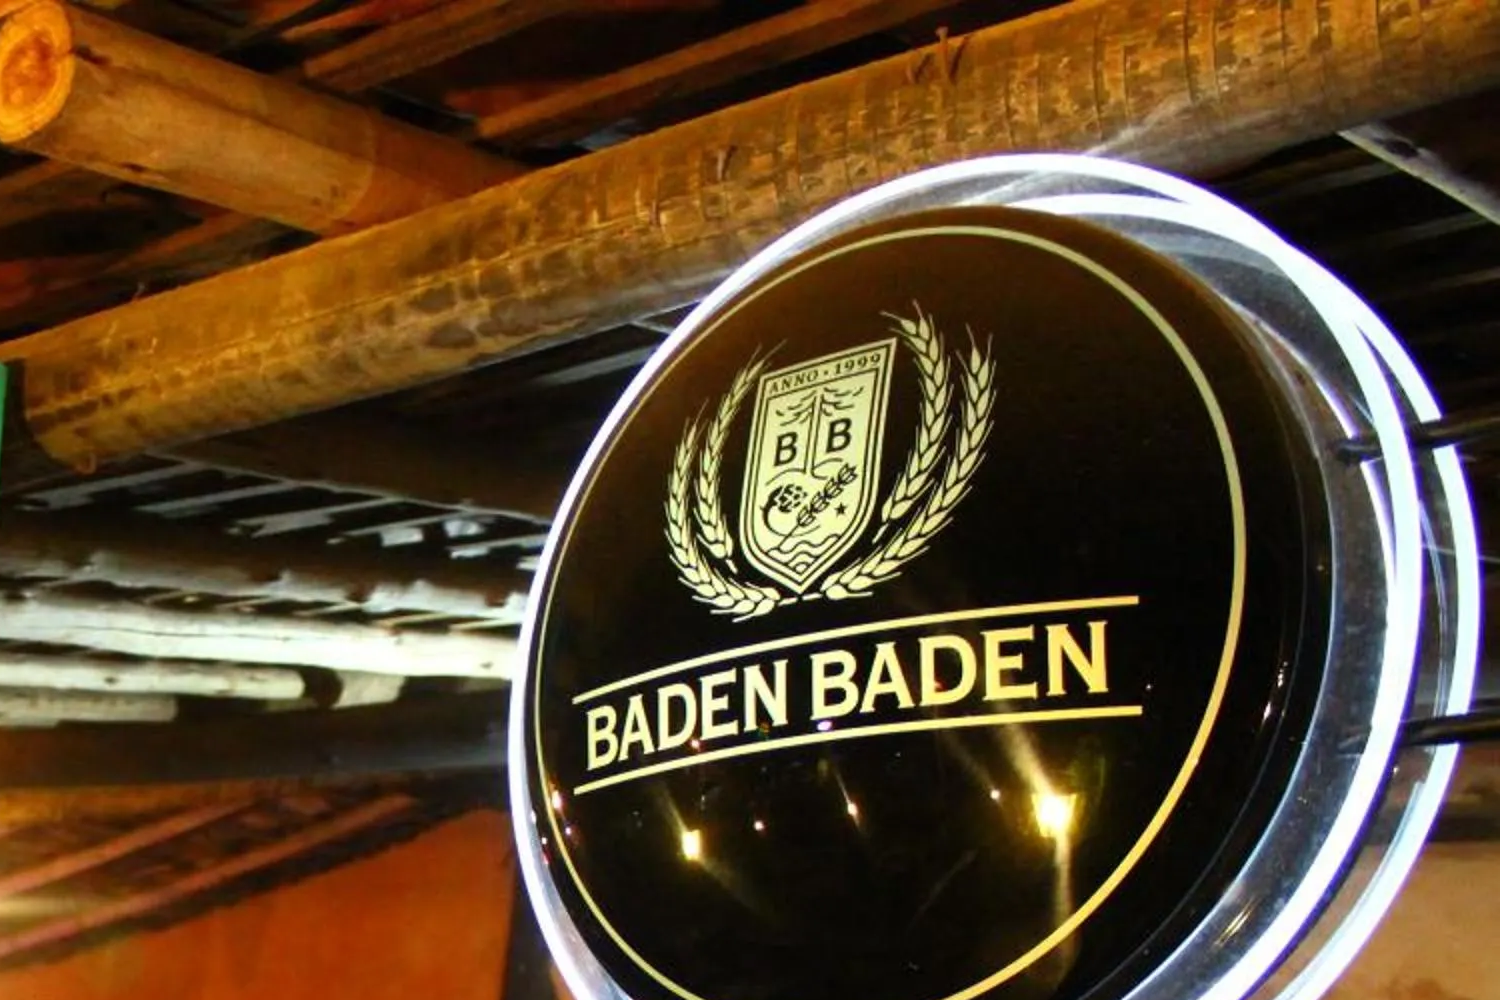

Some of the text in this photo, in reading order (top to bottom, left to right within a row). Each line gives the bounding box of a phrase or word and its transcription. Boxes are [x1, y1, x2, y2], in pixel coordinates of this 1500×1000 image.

[769, 353, 881, 395] ANNO 1999
[773, 417, 853, 467] B B
[586, 620, 1110, 772] BADEN BADEN
